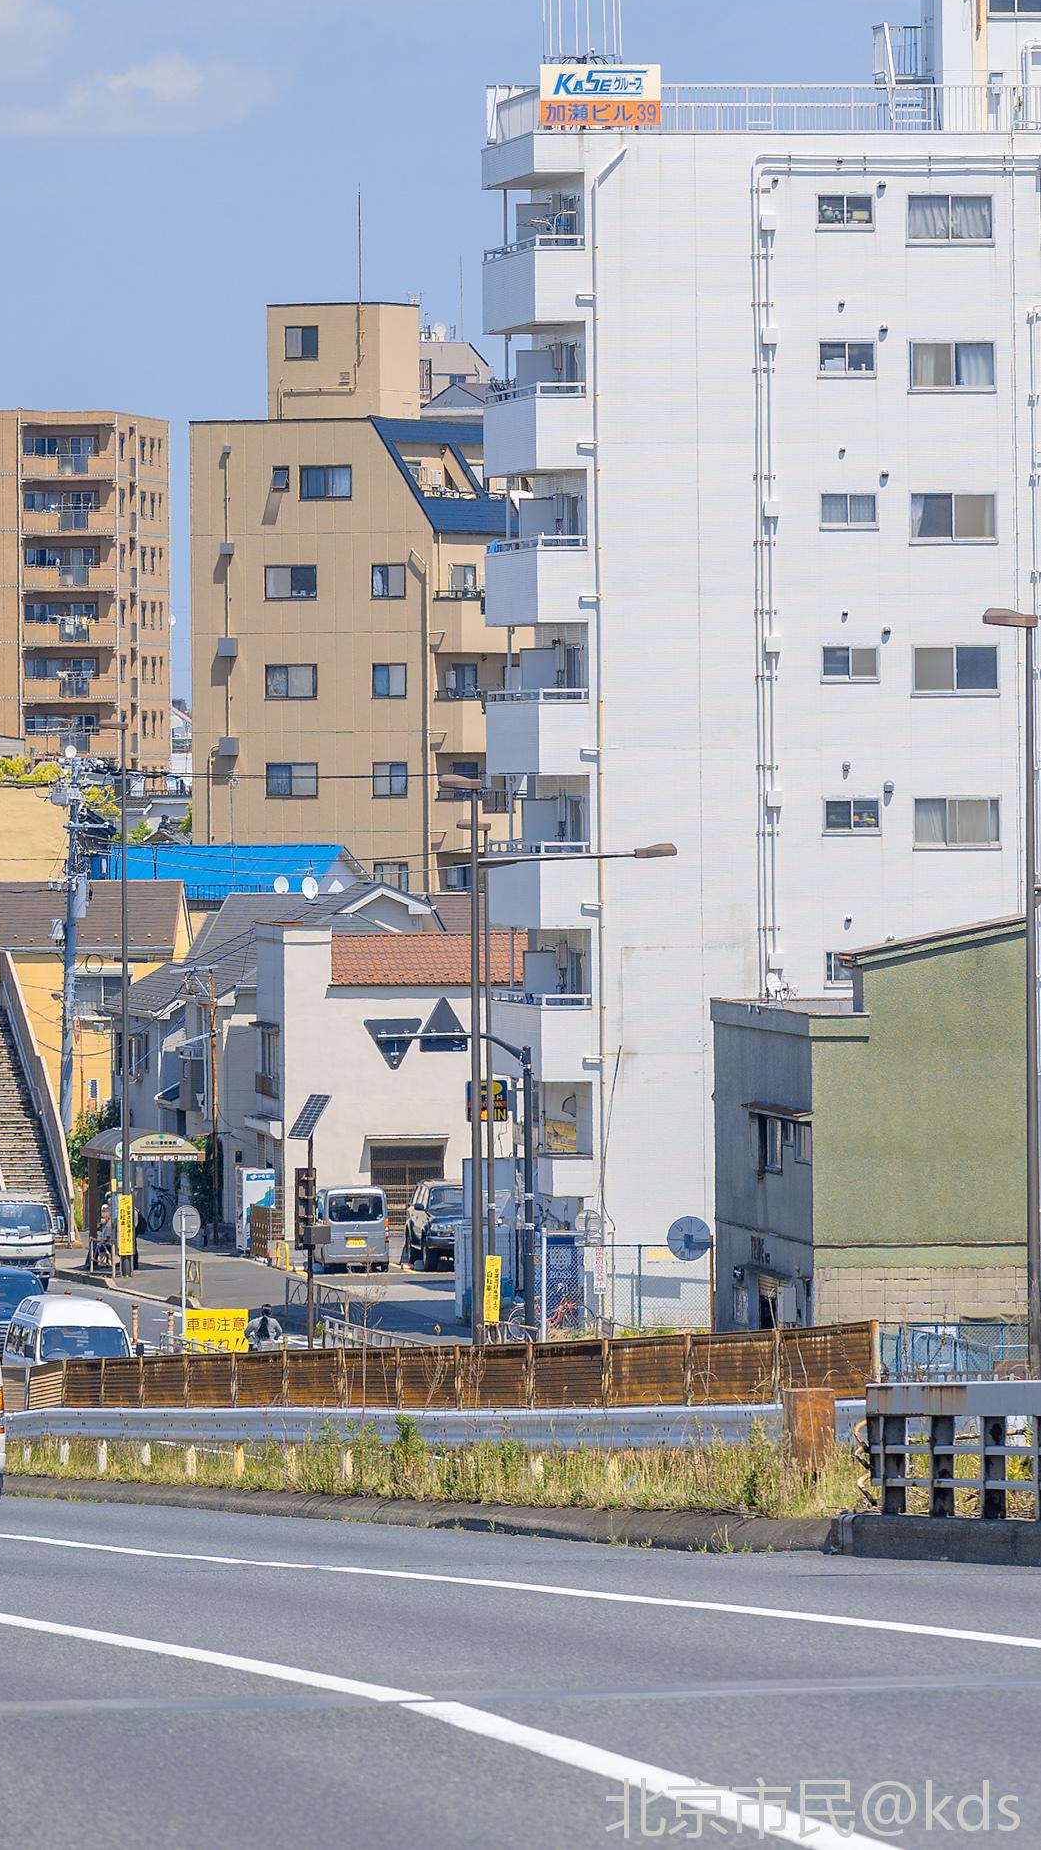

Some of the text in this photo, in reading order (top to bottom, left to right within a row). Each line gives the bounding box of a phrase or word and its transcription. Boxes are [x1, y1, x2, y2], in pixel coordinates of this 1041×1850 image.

[545, 103, 657, 123] 加瀬ビル39
[494, 1108, 506, 1120] IN
